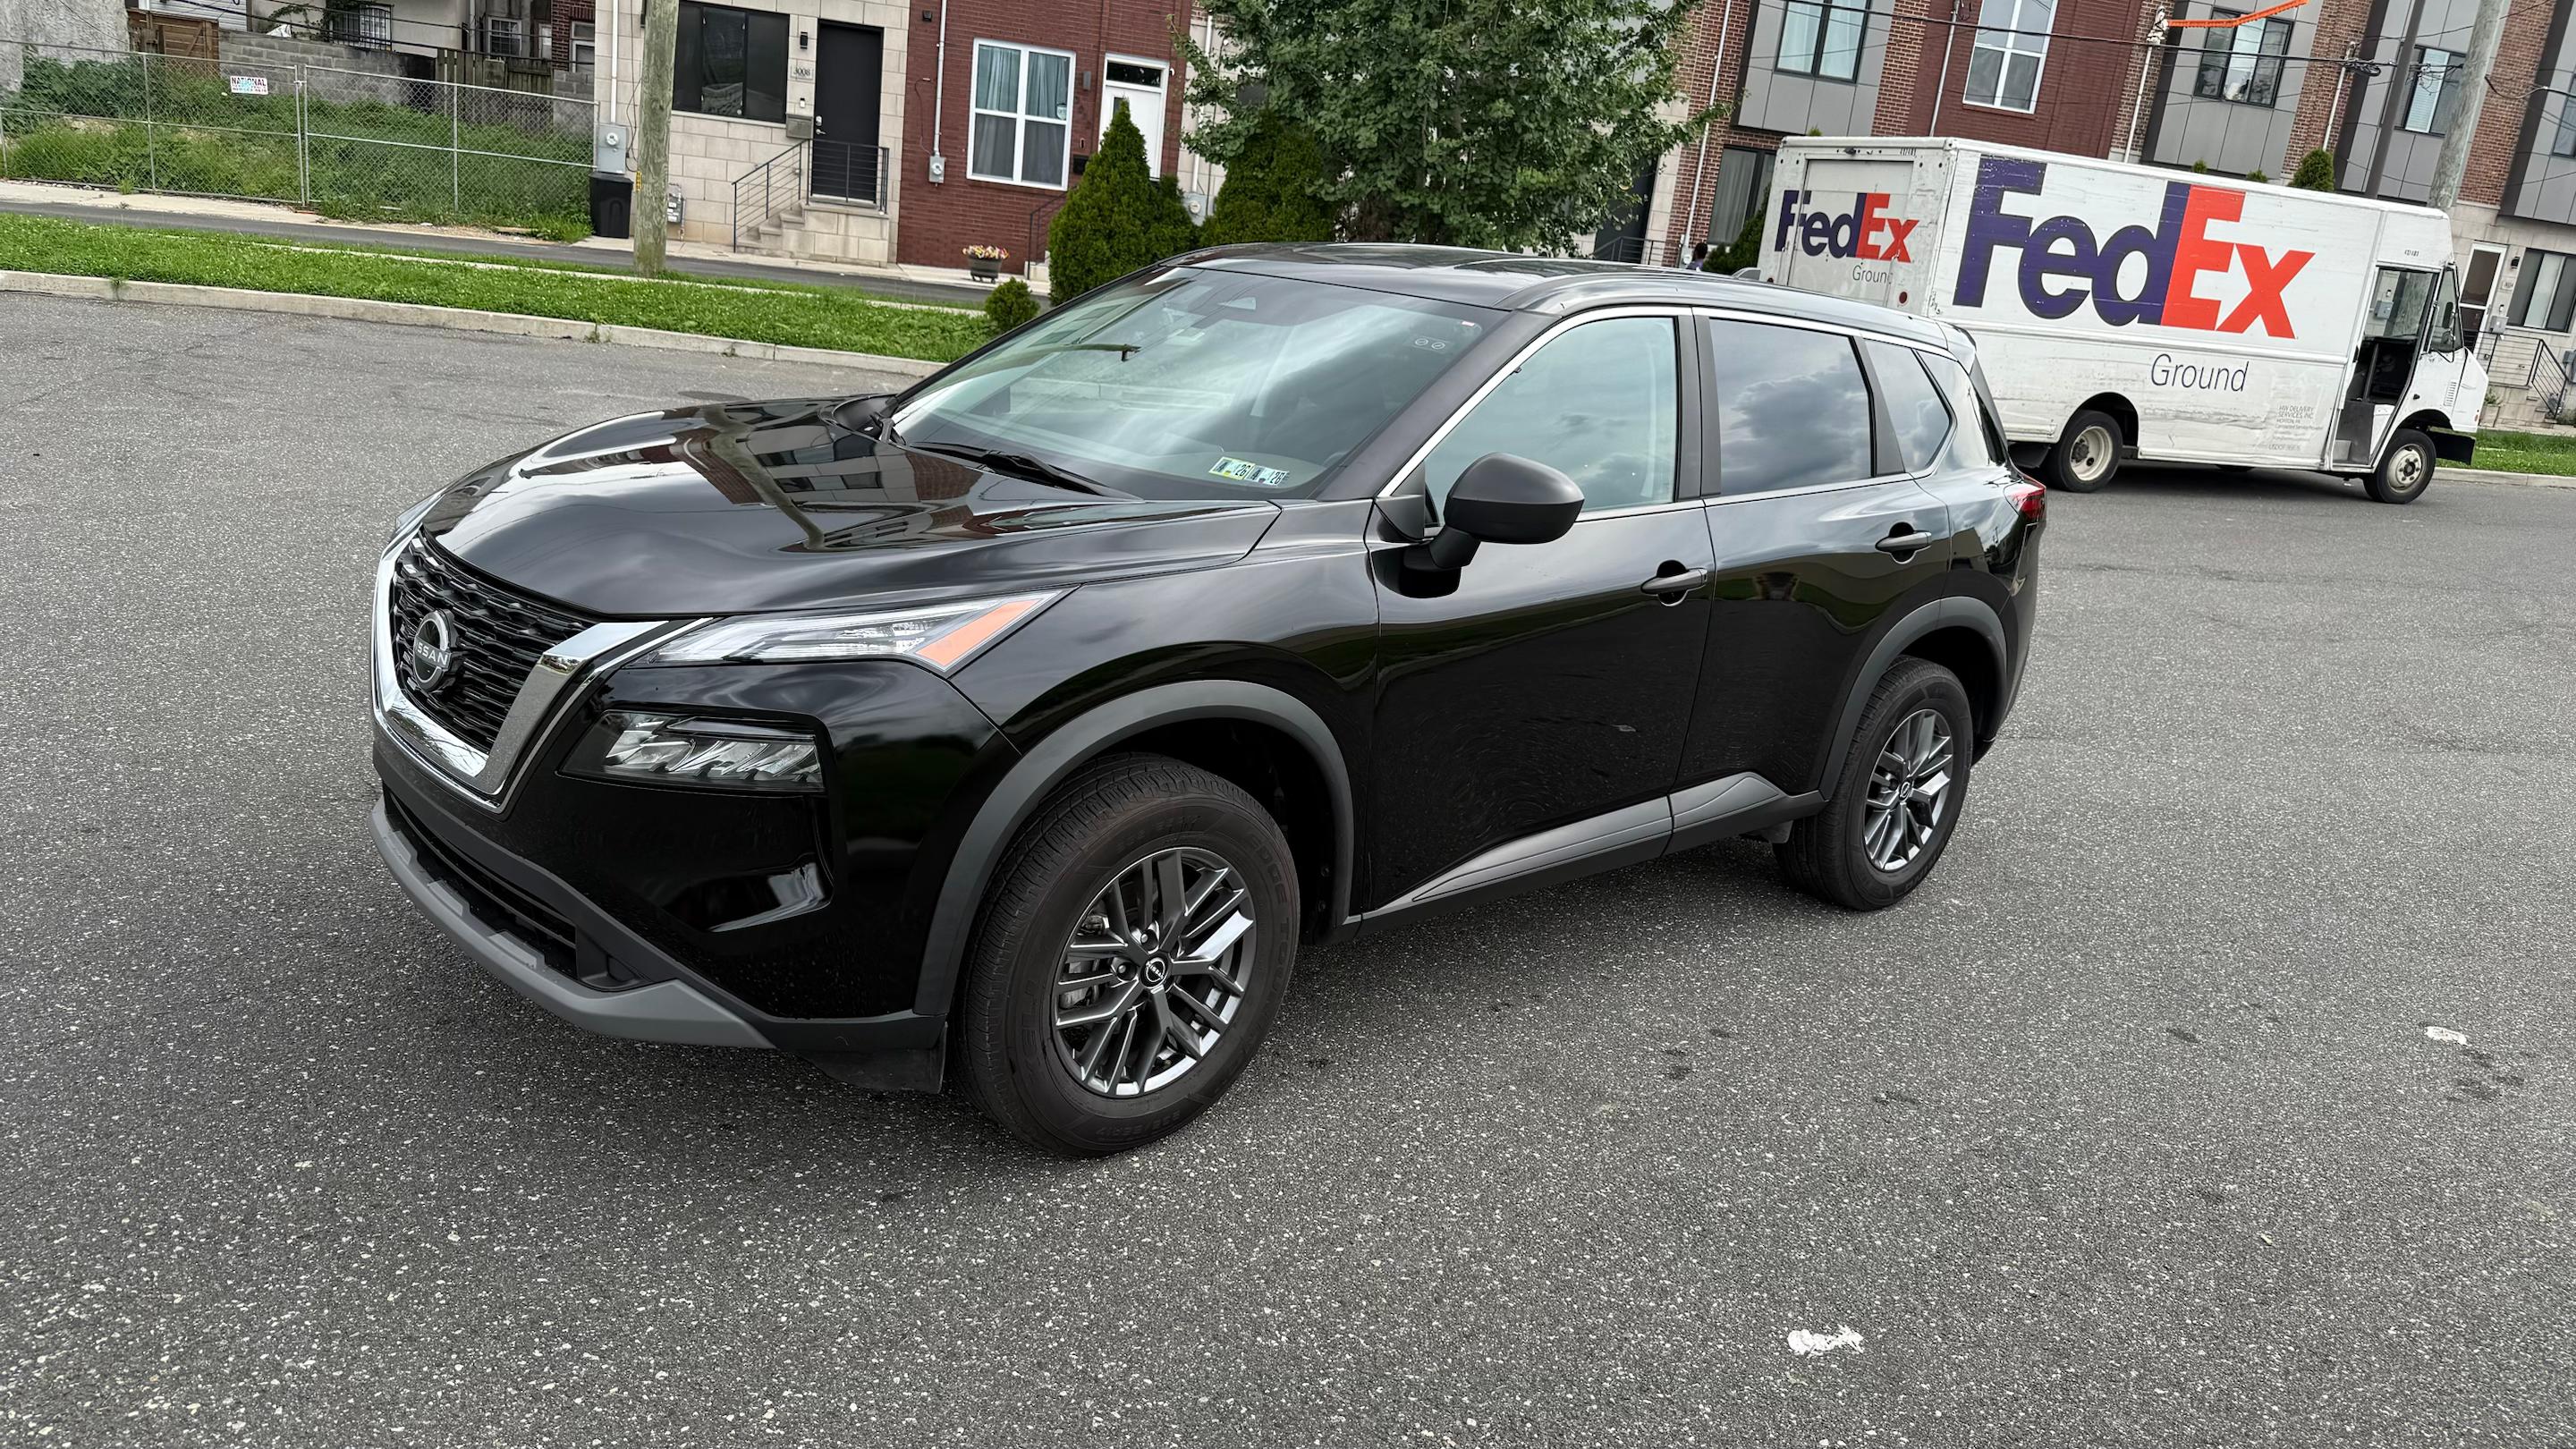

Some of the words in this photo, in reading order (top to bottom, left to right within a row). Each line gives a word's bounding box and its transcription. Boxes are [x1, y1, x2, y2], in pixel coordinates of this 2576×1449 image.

[231, 77, 267, 86] NATIONAL
[1775, 190, 1919, 263] FedEx
[1953, 154, 2316, 339] FedEx
[2150, 353, 2250, 392] Ground
